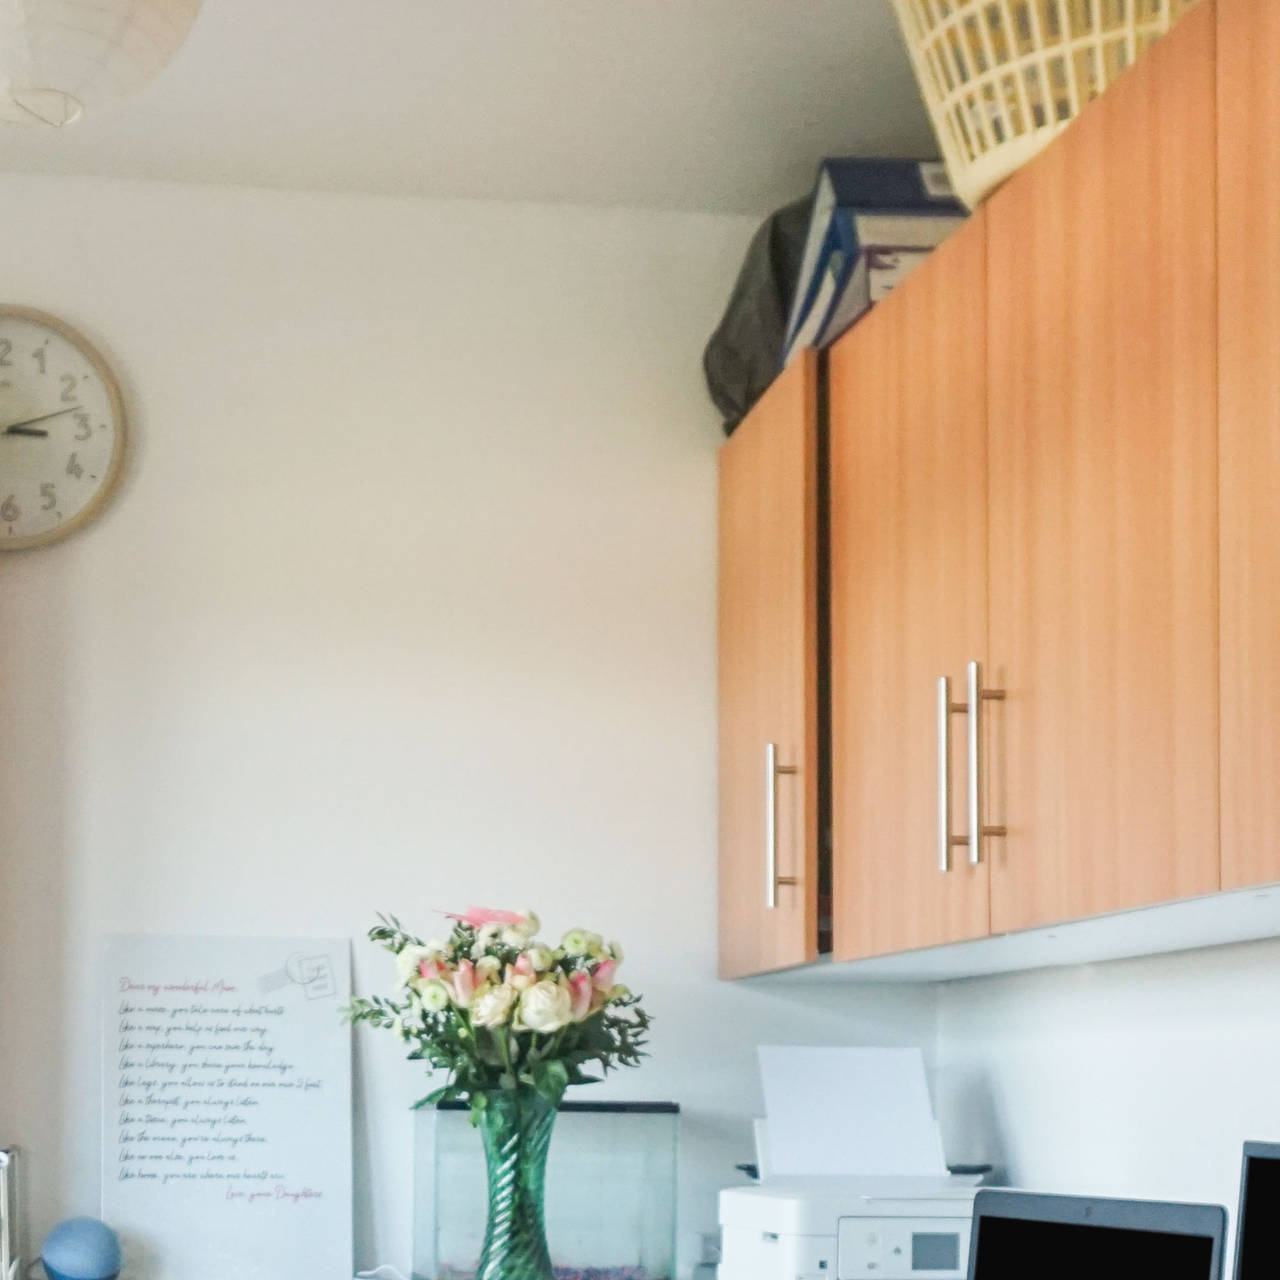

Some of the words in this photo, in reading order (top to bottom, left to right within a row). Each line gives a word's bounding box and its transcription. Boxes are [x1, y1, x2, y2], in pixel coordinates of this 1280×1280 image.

[32, 348, 46, 374] 1
[60, 374, 78, 402] 2
[74, 413, 92, 441] 3
[66, 452, 84, 479] 4
[0, 494, 19, 522] 6
[40, 483, 57, 511] 5
